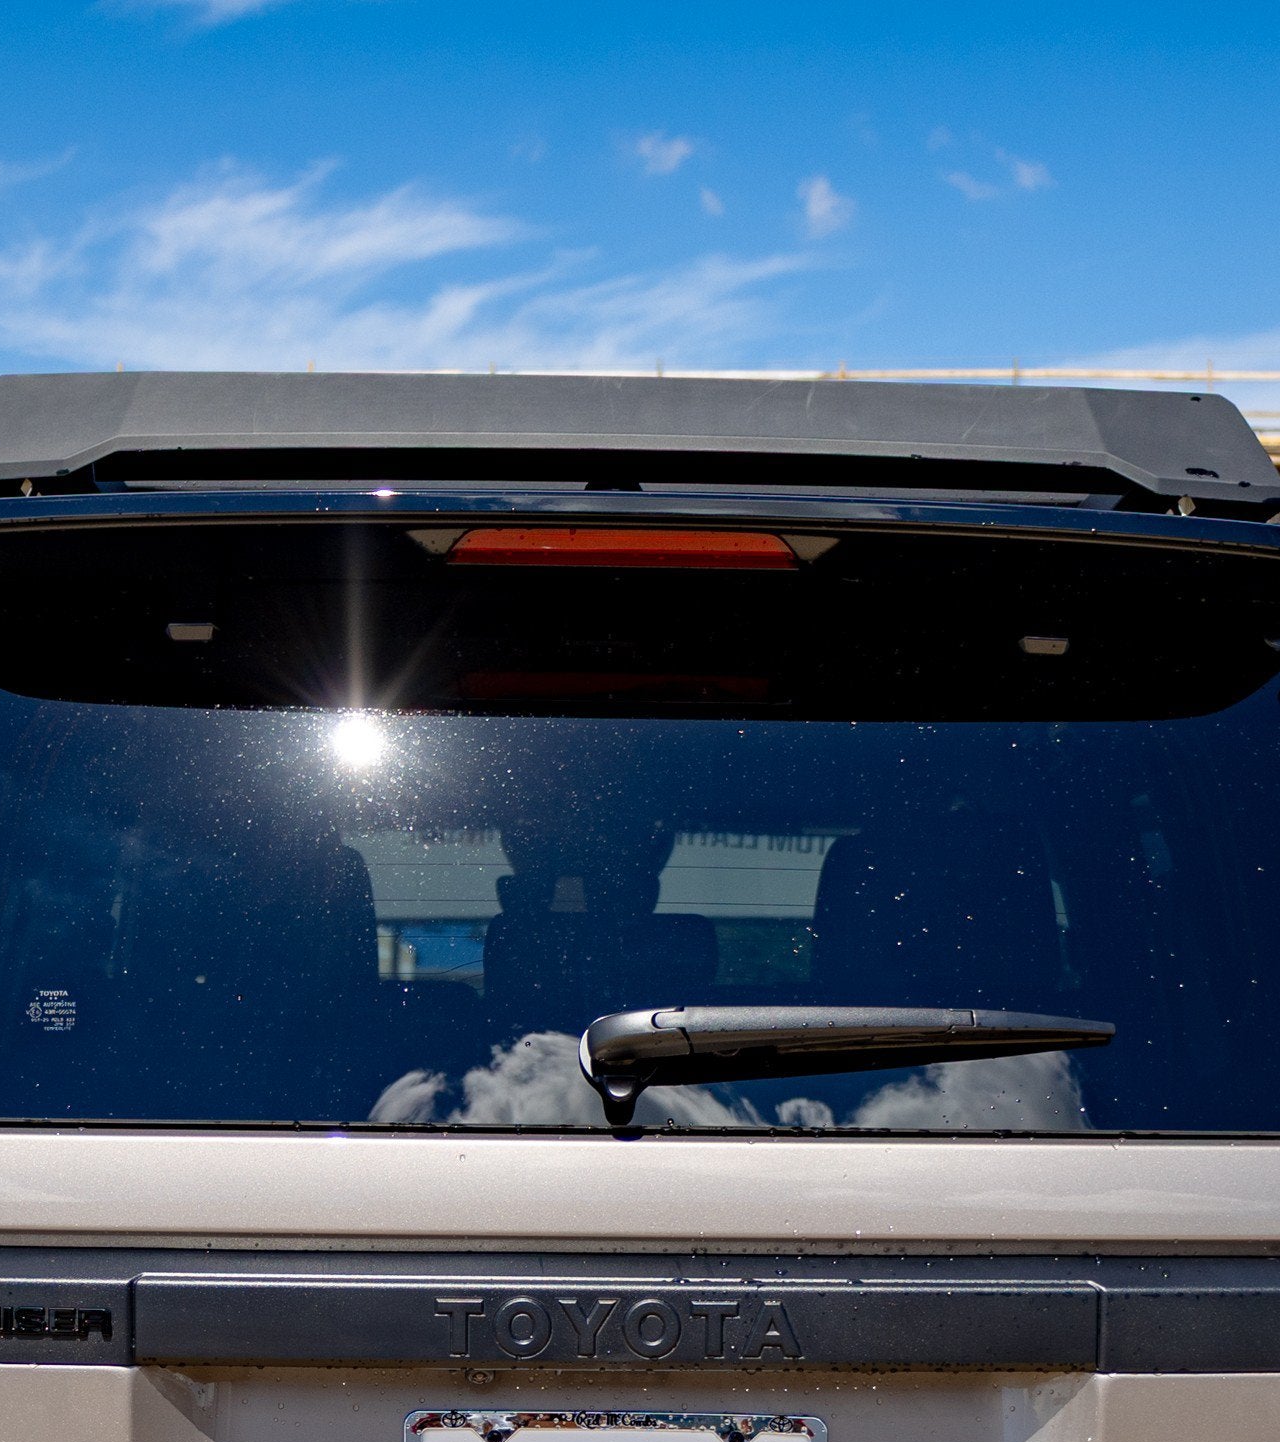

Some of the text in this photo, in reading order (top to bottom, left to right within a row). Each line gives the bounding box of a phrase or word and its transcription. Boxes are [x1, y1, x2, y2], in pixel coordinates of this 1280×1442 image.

[434, 1296, 806, 1360] TOYOTA
[576, 1411, 657, 1429] Red McCombs
